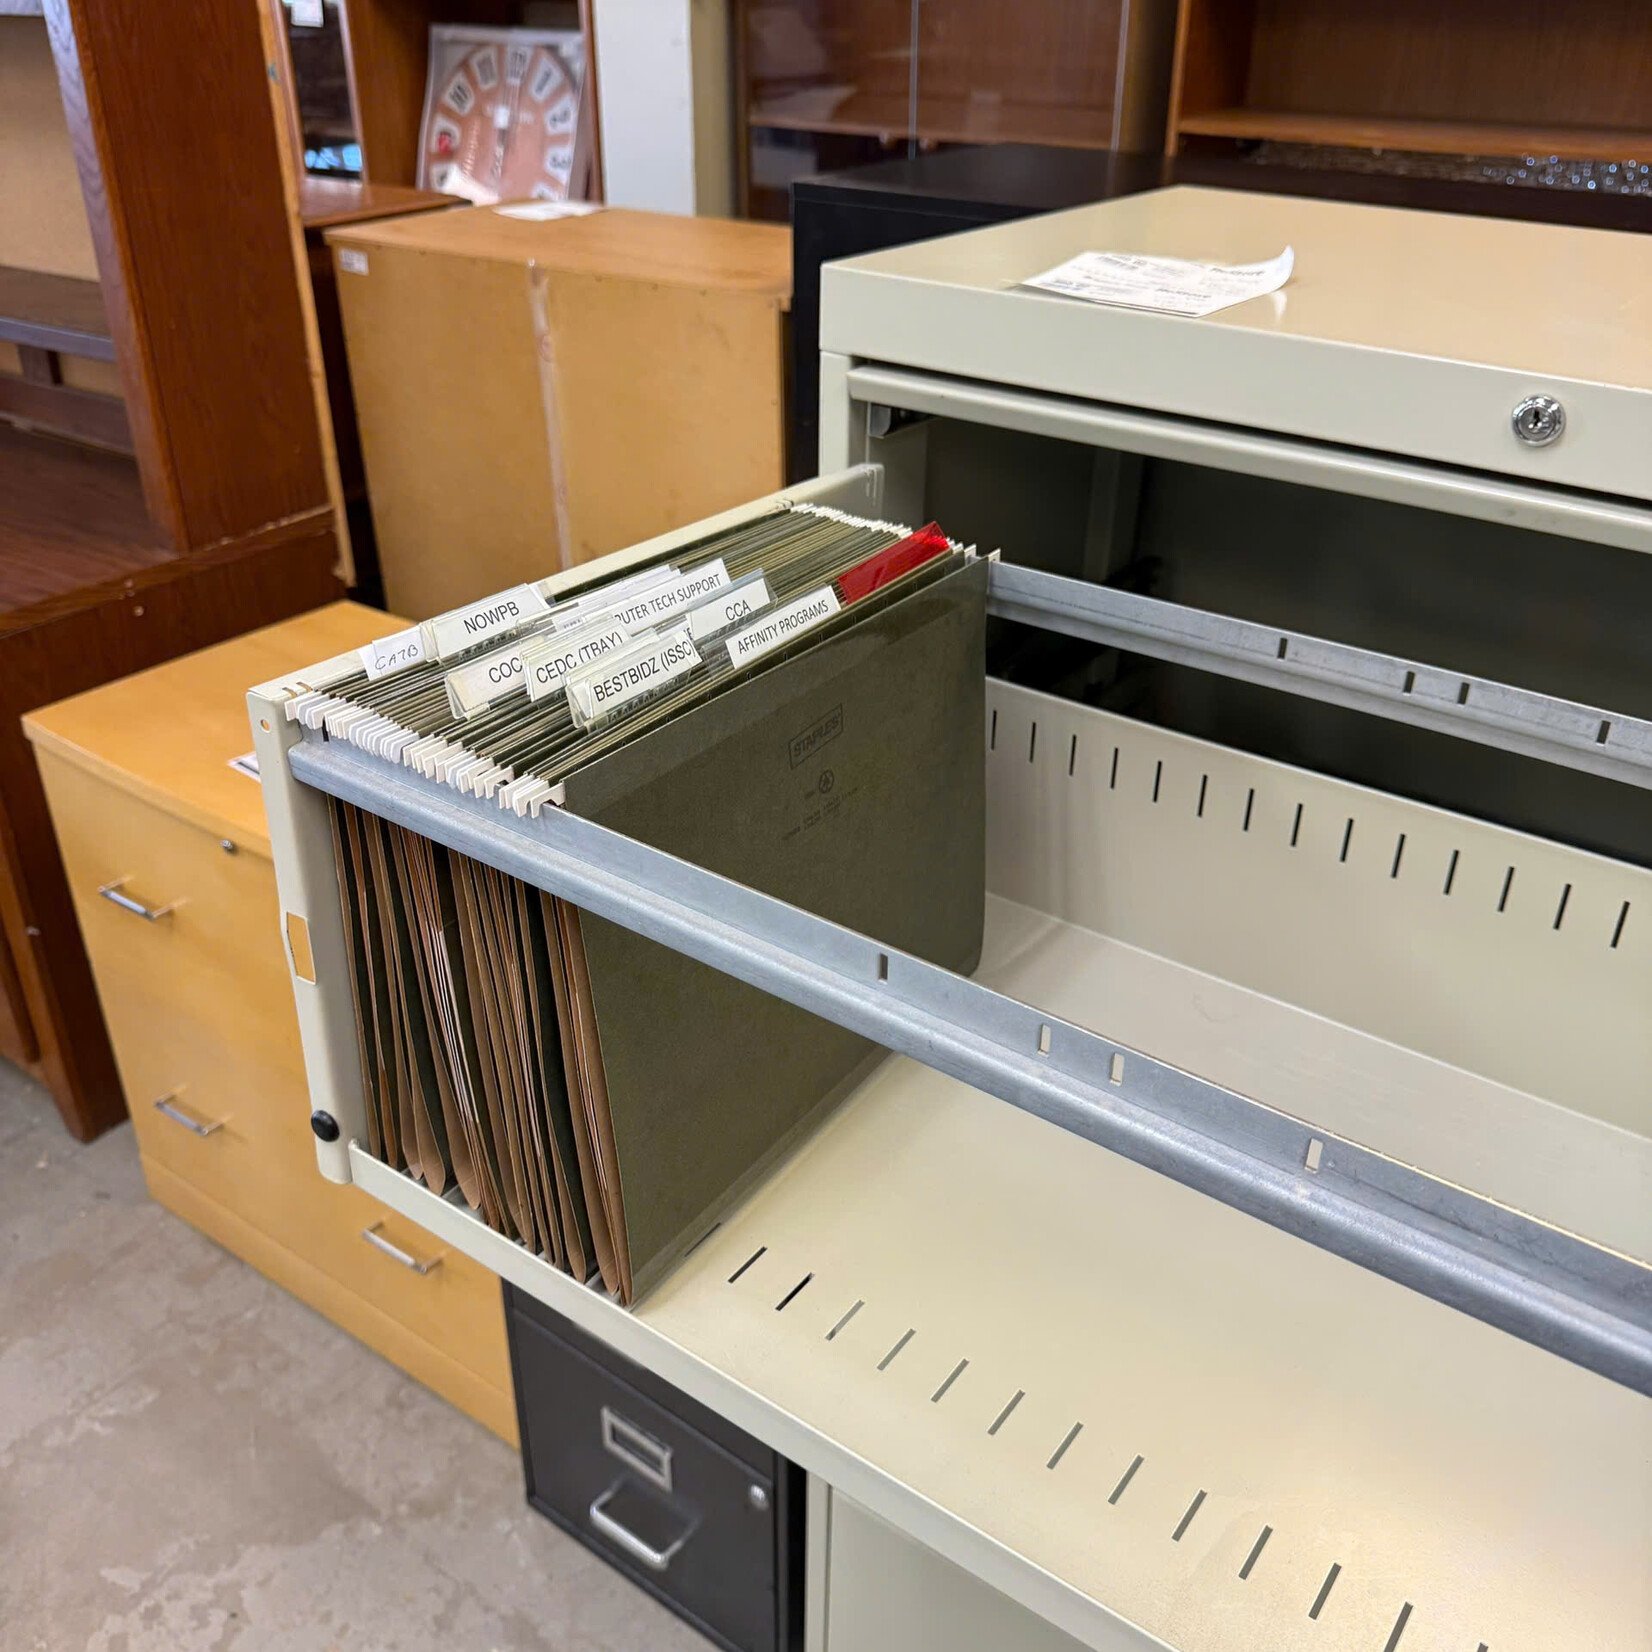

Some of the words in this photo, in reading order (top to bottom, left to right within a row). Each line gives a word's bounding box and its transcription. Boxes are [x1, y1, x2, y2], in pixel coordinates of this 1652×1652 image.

[648, 592, 678, 613] TECH
[677, 574, 721, 602] SUPPORT
[725, 600, 752, 621] CCA
[463, 601, 520, 634] NOWPB
[737, 623, 778, 654] AFFINITY
[779, 600, 829, 634] PROGRAMS
[536, 653, 577, 684] CEDC
[578, 631, 623, 664] (TBAY)
[593, 658, 660, 702] BESTBIDZ
[793, 715, 839, 757] STAPLES
